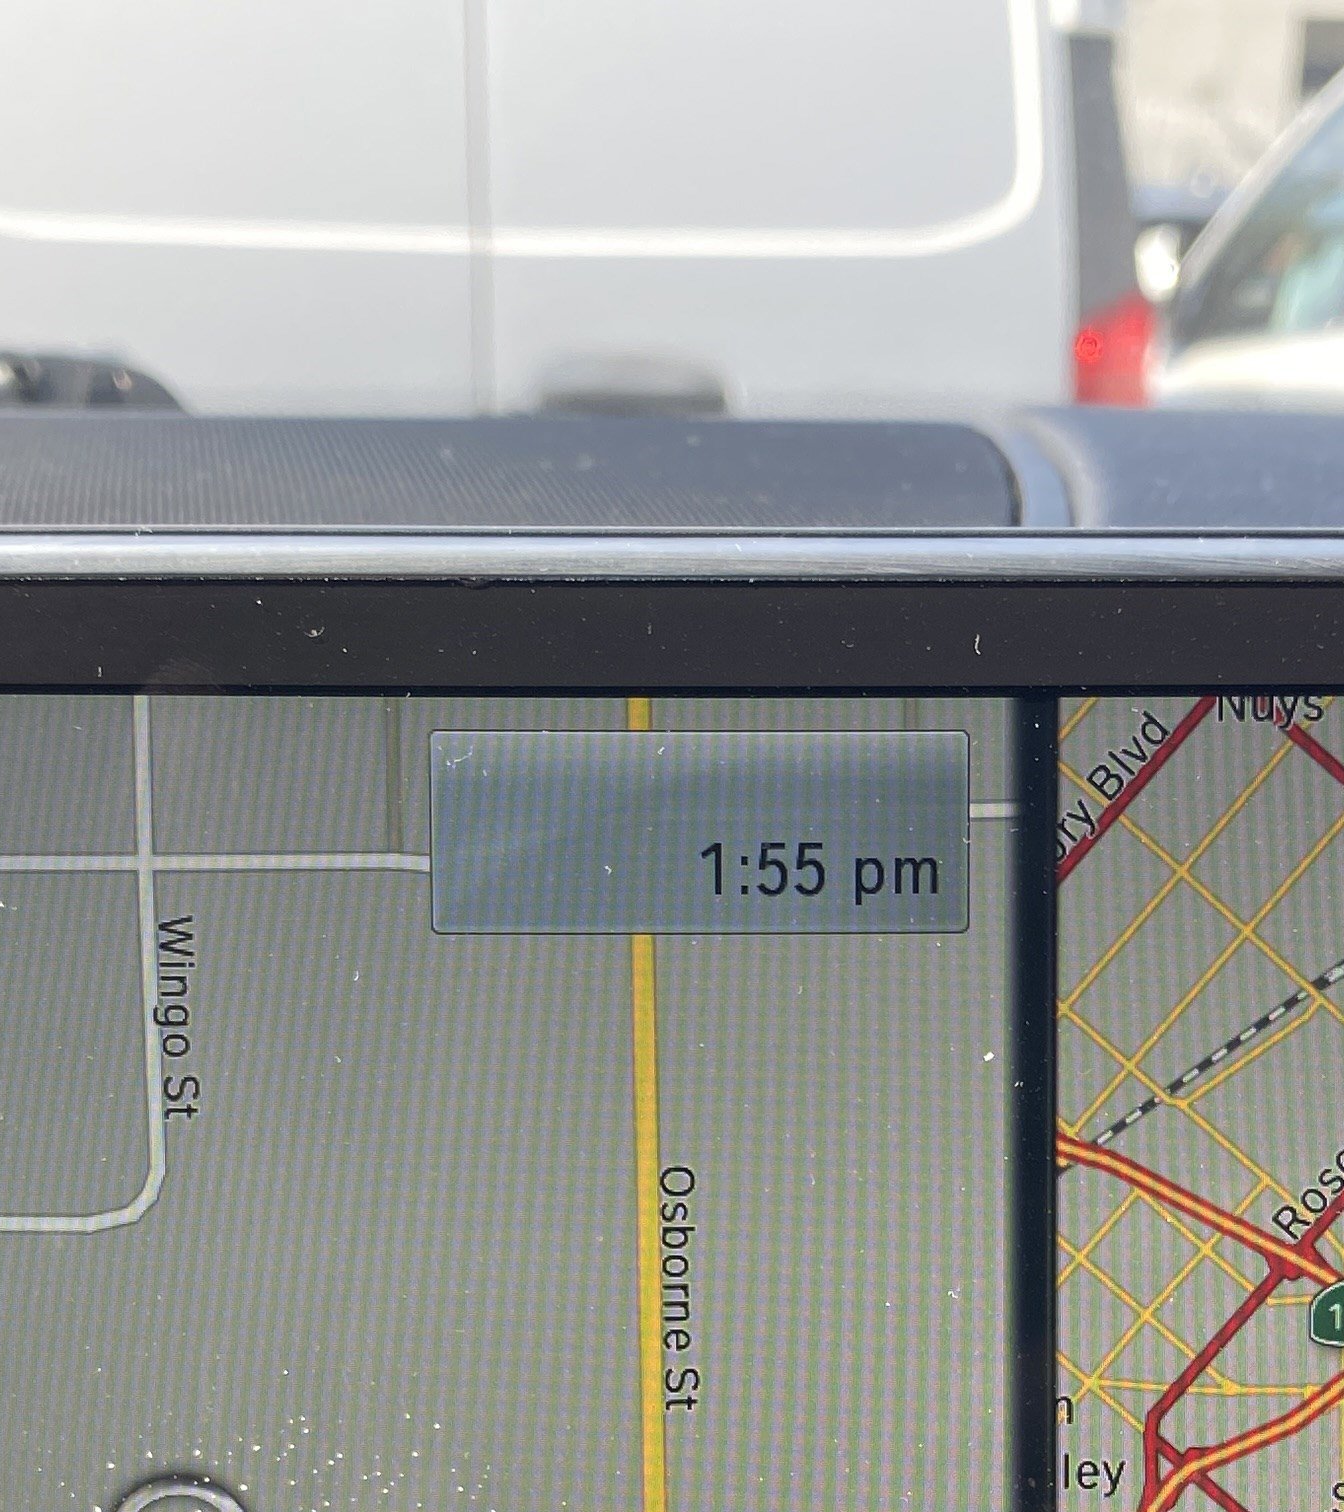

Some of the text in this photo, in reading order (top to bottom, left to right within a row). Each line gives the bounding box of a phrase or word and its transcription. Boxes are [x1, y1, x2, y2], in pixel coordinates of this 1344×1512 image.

[1086, 710, 1172, 801] Blvd
[698, 841, 941, 906] 1:55 pm
[153, 914, 200, 1121] Wingo St
[659, 1166, 701, 1411] Osborne St
